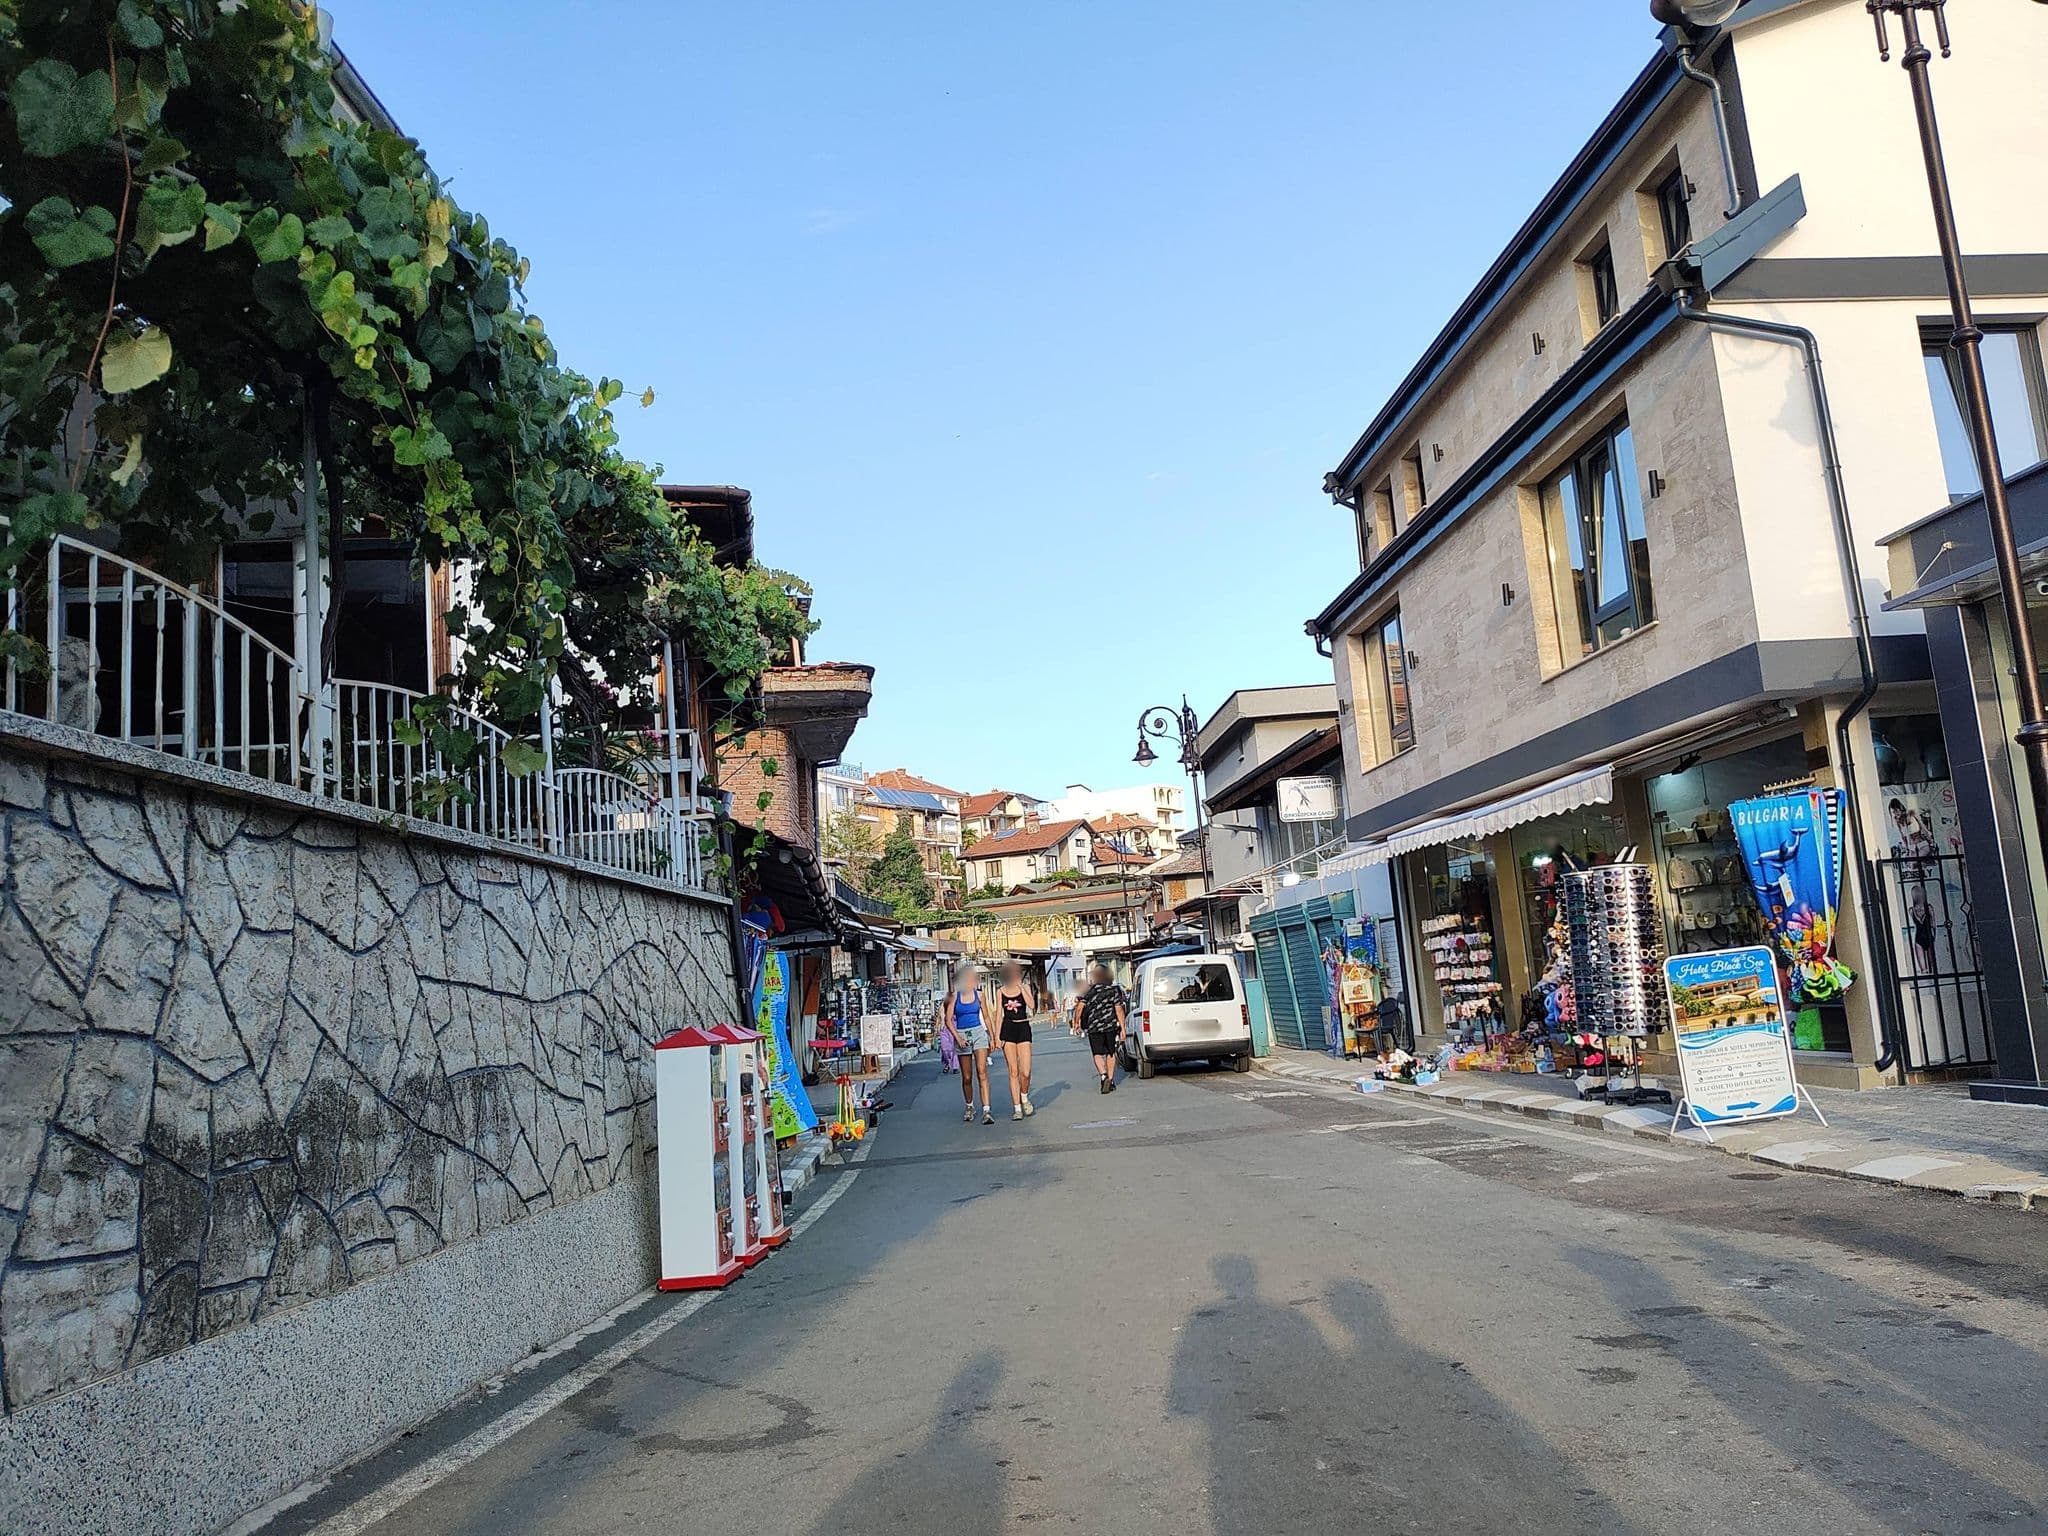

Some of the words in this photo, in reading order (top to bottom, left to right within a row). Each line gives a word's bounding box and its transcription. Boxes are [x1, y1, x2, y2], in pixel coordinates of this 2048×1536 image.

[1738, 805, 1804, 826] BULGARIA
[1676, 963, 1709, 978] Hotel
[1711, 960, 1741, 973] Black
[1743, 956, 1765, 969] Sea
